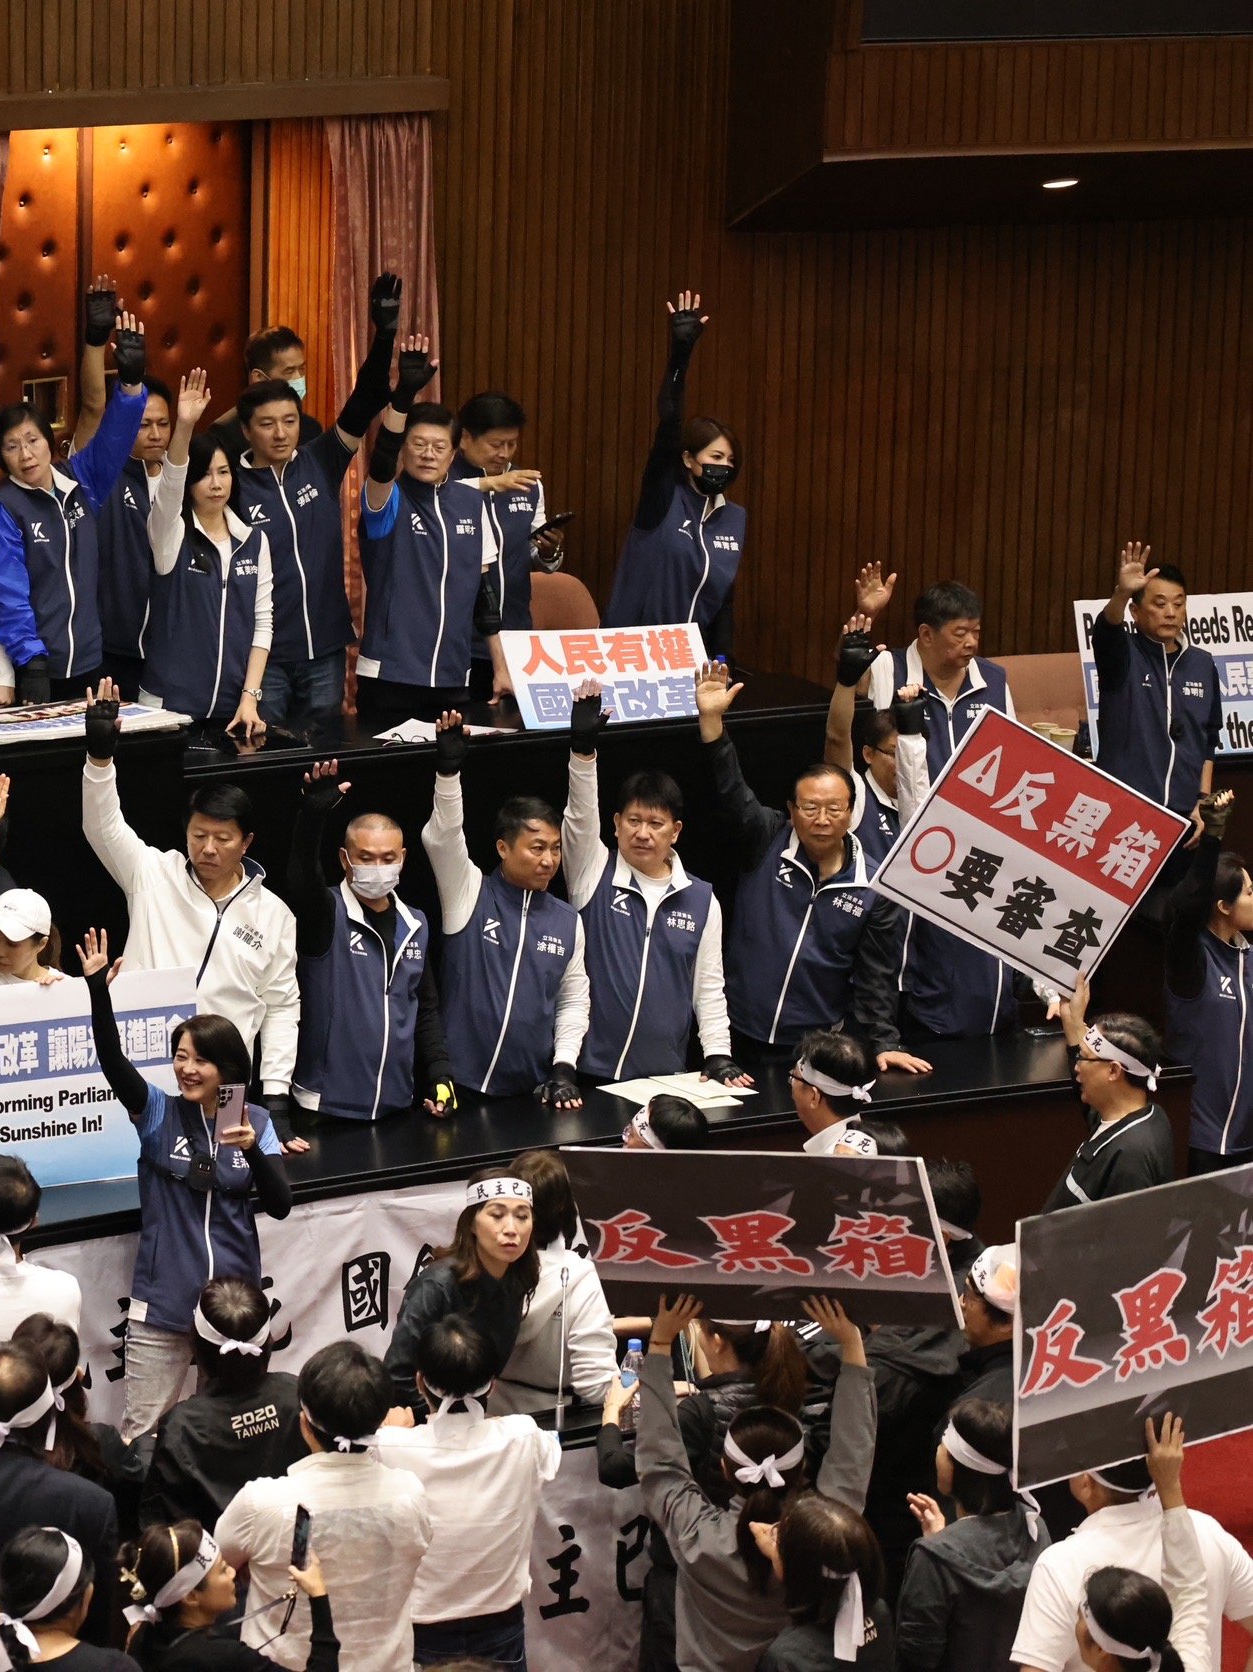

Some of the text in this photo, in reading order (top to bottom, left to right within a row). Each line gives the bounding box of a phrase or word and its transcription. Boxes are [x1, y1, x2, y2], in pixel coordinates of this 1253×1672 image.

[522, 628, 697, 677] 人民有權
[990, 769, 1162, 891] 反黑箱
[832, 896, 865, 918] 林德福
[940, 845, 1105, 971] 要審查
[667, 916, 695, 932] 林思銘
[0, 1119, 77, 1144] Sunshine
[82, 1115, 103, 1133] In!
[585, 1208, 936, 1281] 反黑箱
[230, 1404, 278, 1430] 2020
[234, 1417, 280, 1440] TAIWAN
